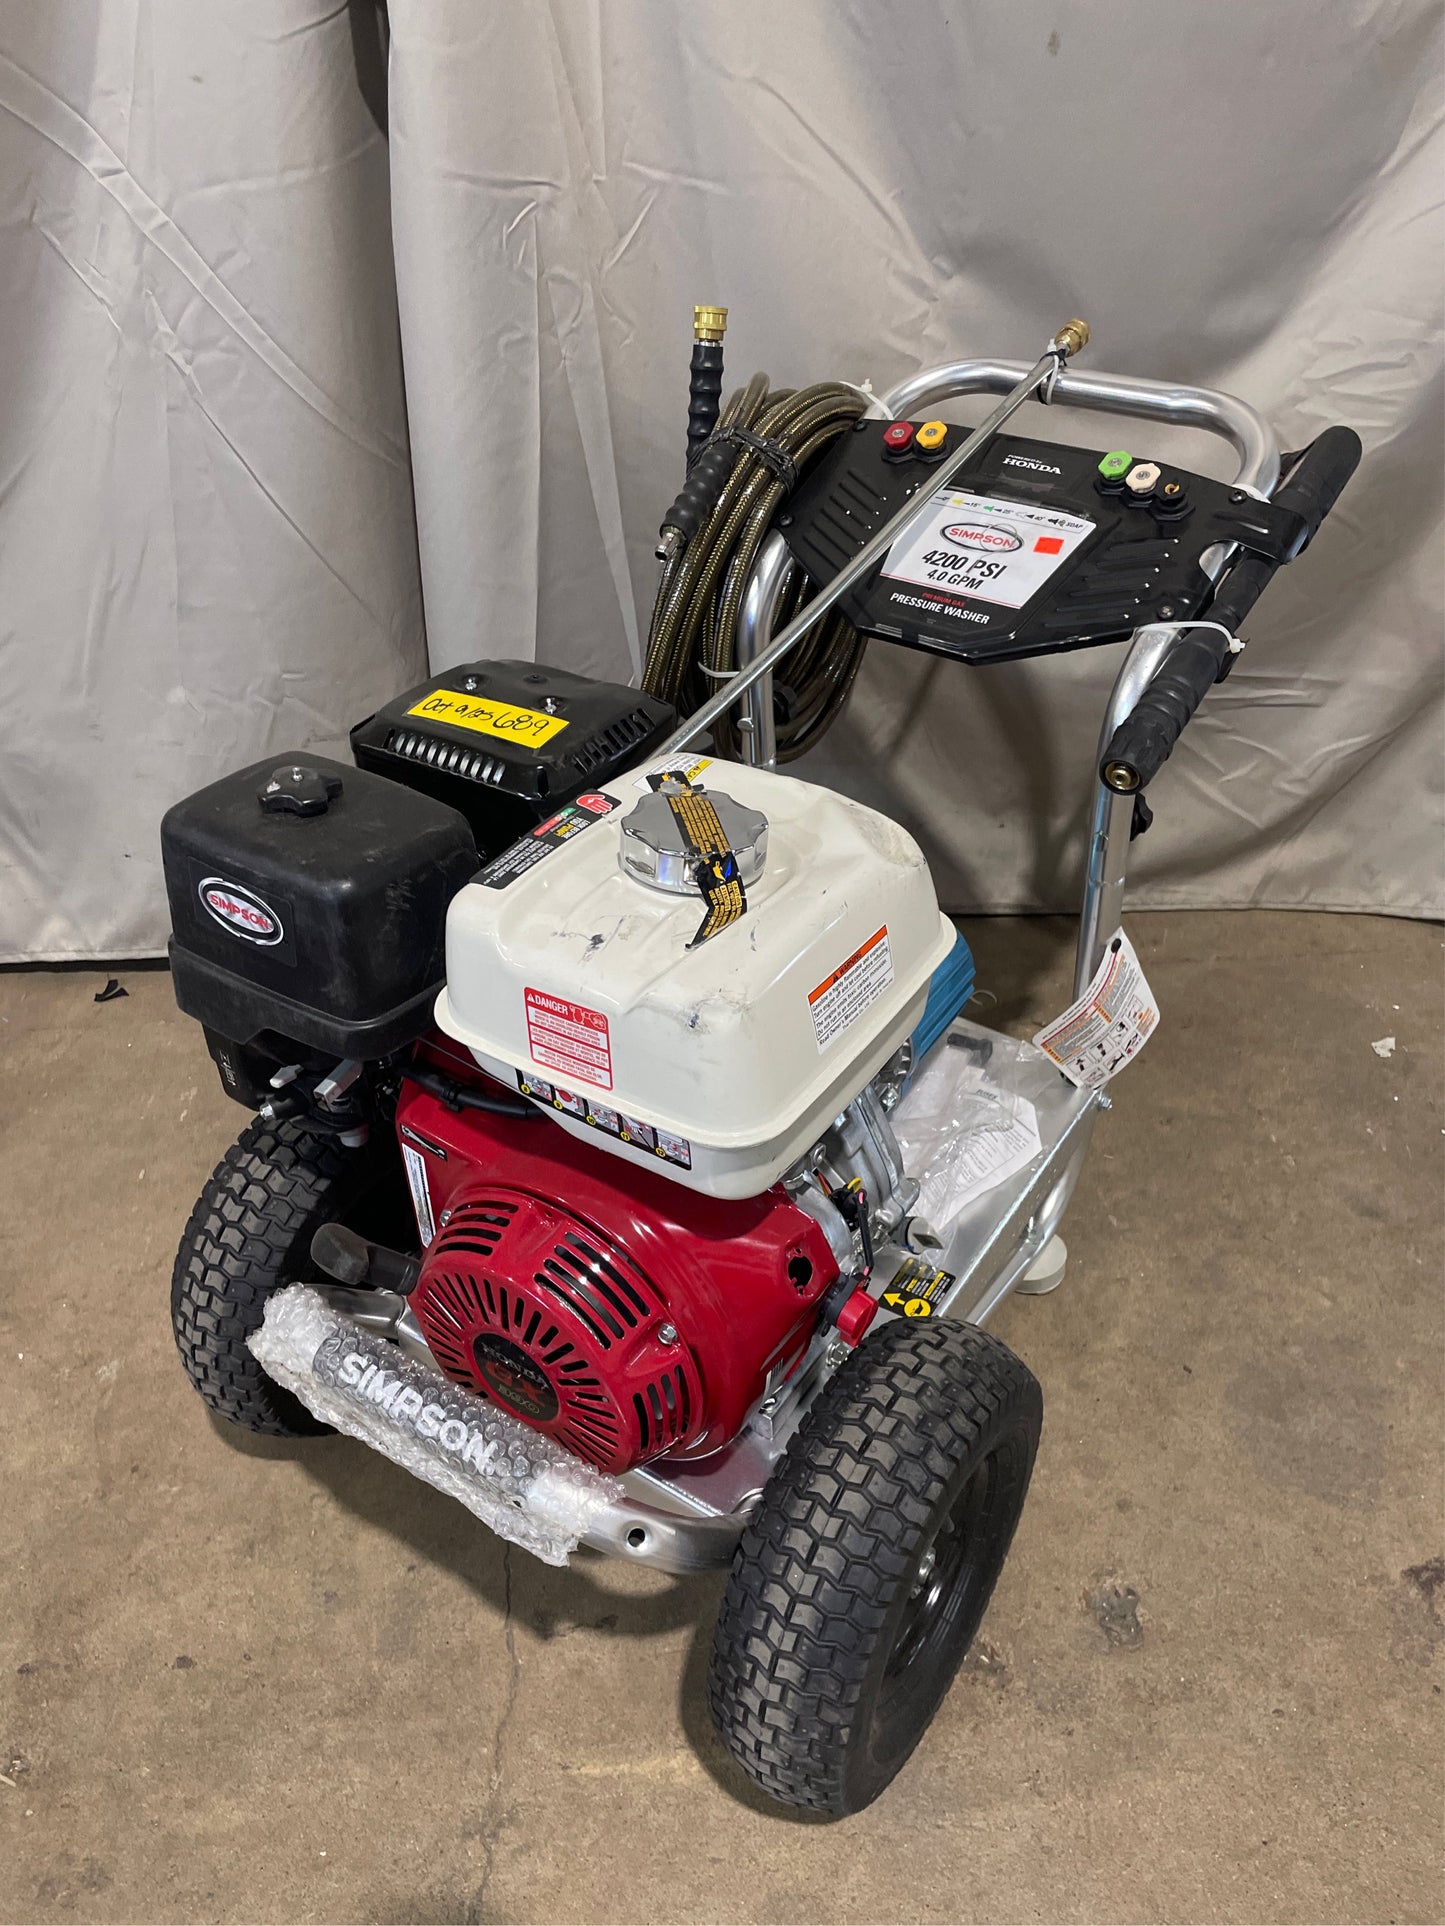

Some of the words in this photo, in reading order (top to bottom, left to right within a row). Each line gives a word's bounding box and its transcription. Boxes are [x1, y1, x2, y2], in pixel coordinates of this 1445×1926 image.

[1003, 457, 1062, 475] HONDA
[949, 528, 1014, 549] SIMPSON
[922, 550, 969, 571] 4200
[966, 559, 1008, 579] PSI
[927, 570, 948, 582] 4.0
[947, 573, 984, 590] GPM
[890, 592, 944, 613] PRESSURE
[943, 605, 990, 625] WASHER
[493, 711, 550, 736] 689
[732, 881, 742, 908] CAUTION
[210, 894, 271, 930] SIMPSON
[534, 994, 569, 1016] DANGER
[338, 1352, 500, 1477] SIMPSON
